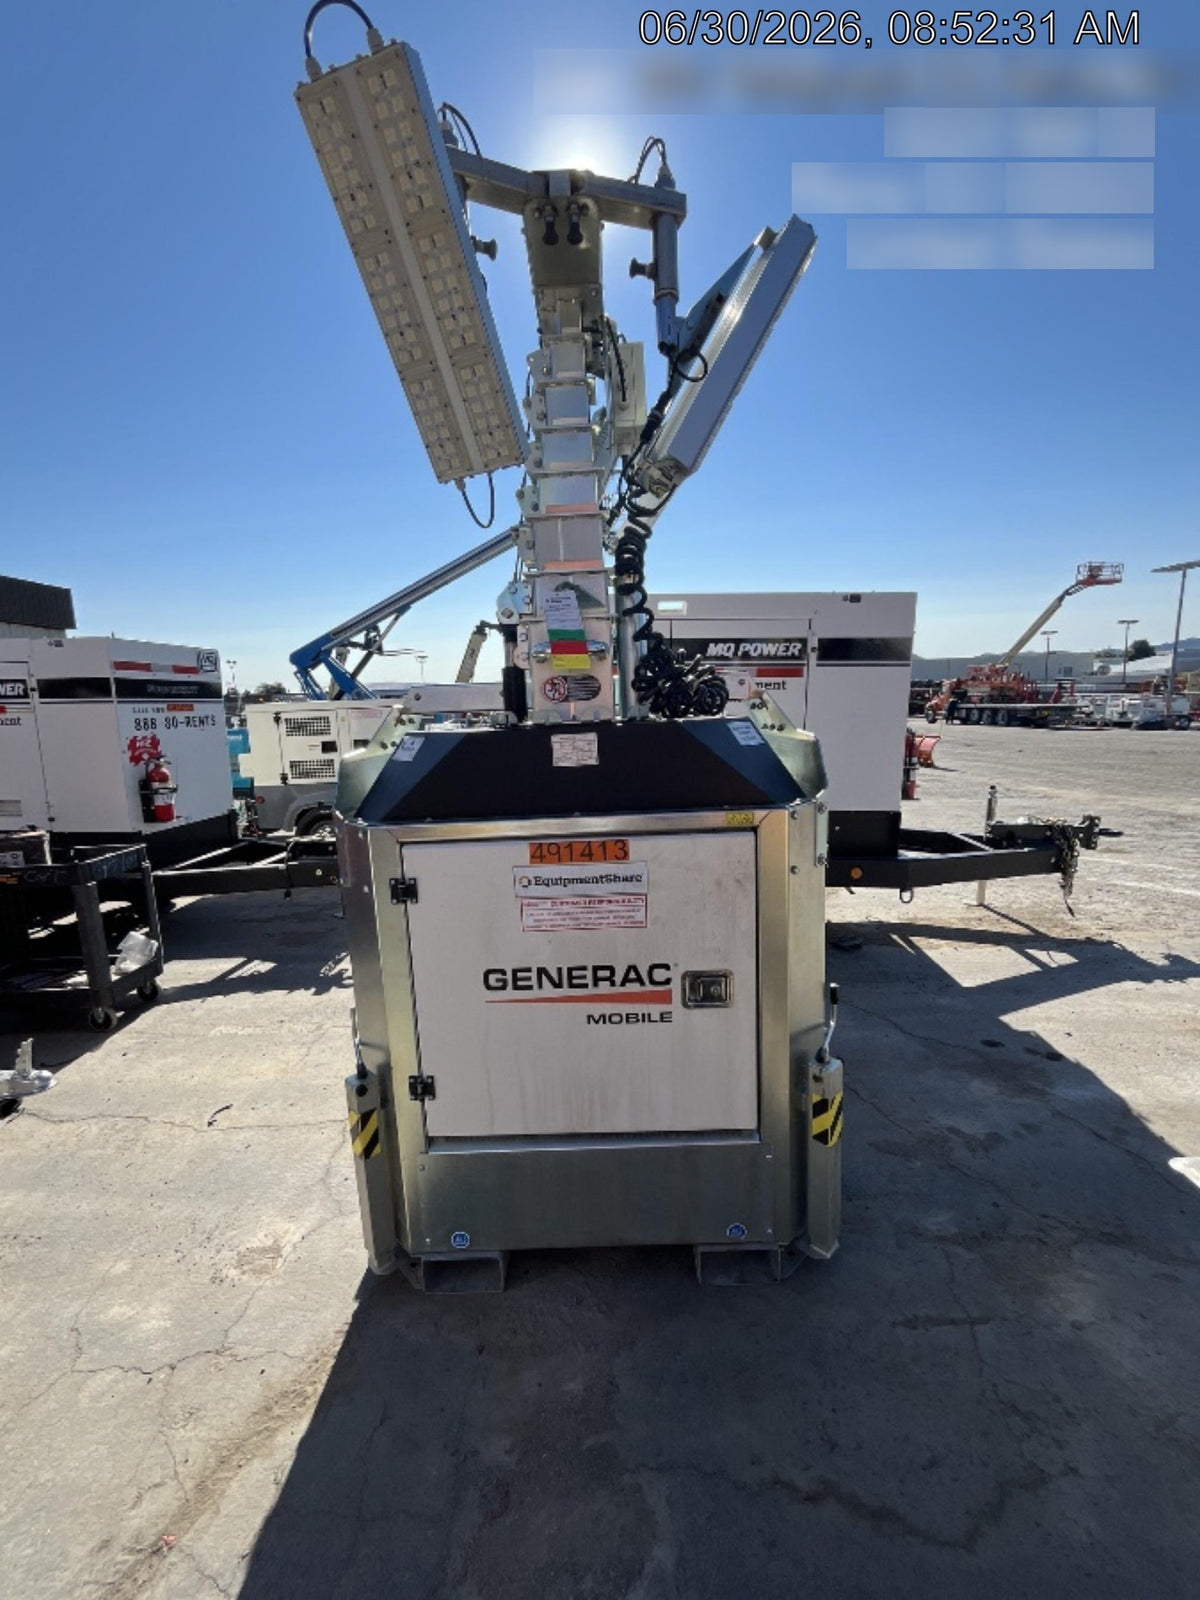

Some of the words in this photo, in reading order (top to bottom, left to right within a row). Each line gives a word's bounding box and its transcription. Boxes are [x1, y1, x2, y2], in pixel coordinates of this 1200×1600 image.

[706, 642, 735, 658] MQ
[737, 642, 802, 657] POWER
[530, 839, 630, 863] 491413
[533, 873, 643, 889] EquipmentShare
[483, 962, 673, 991] GENERAC
[586, 1011, 673, 1025] MOBILE
